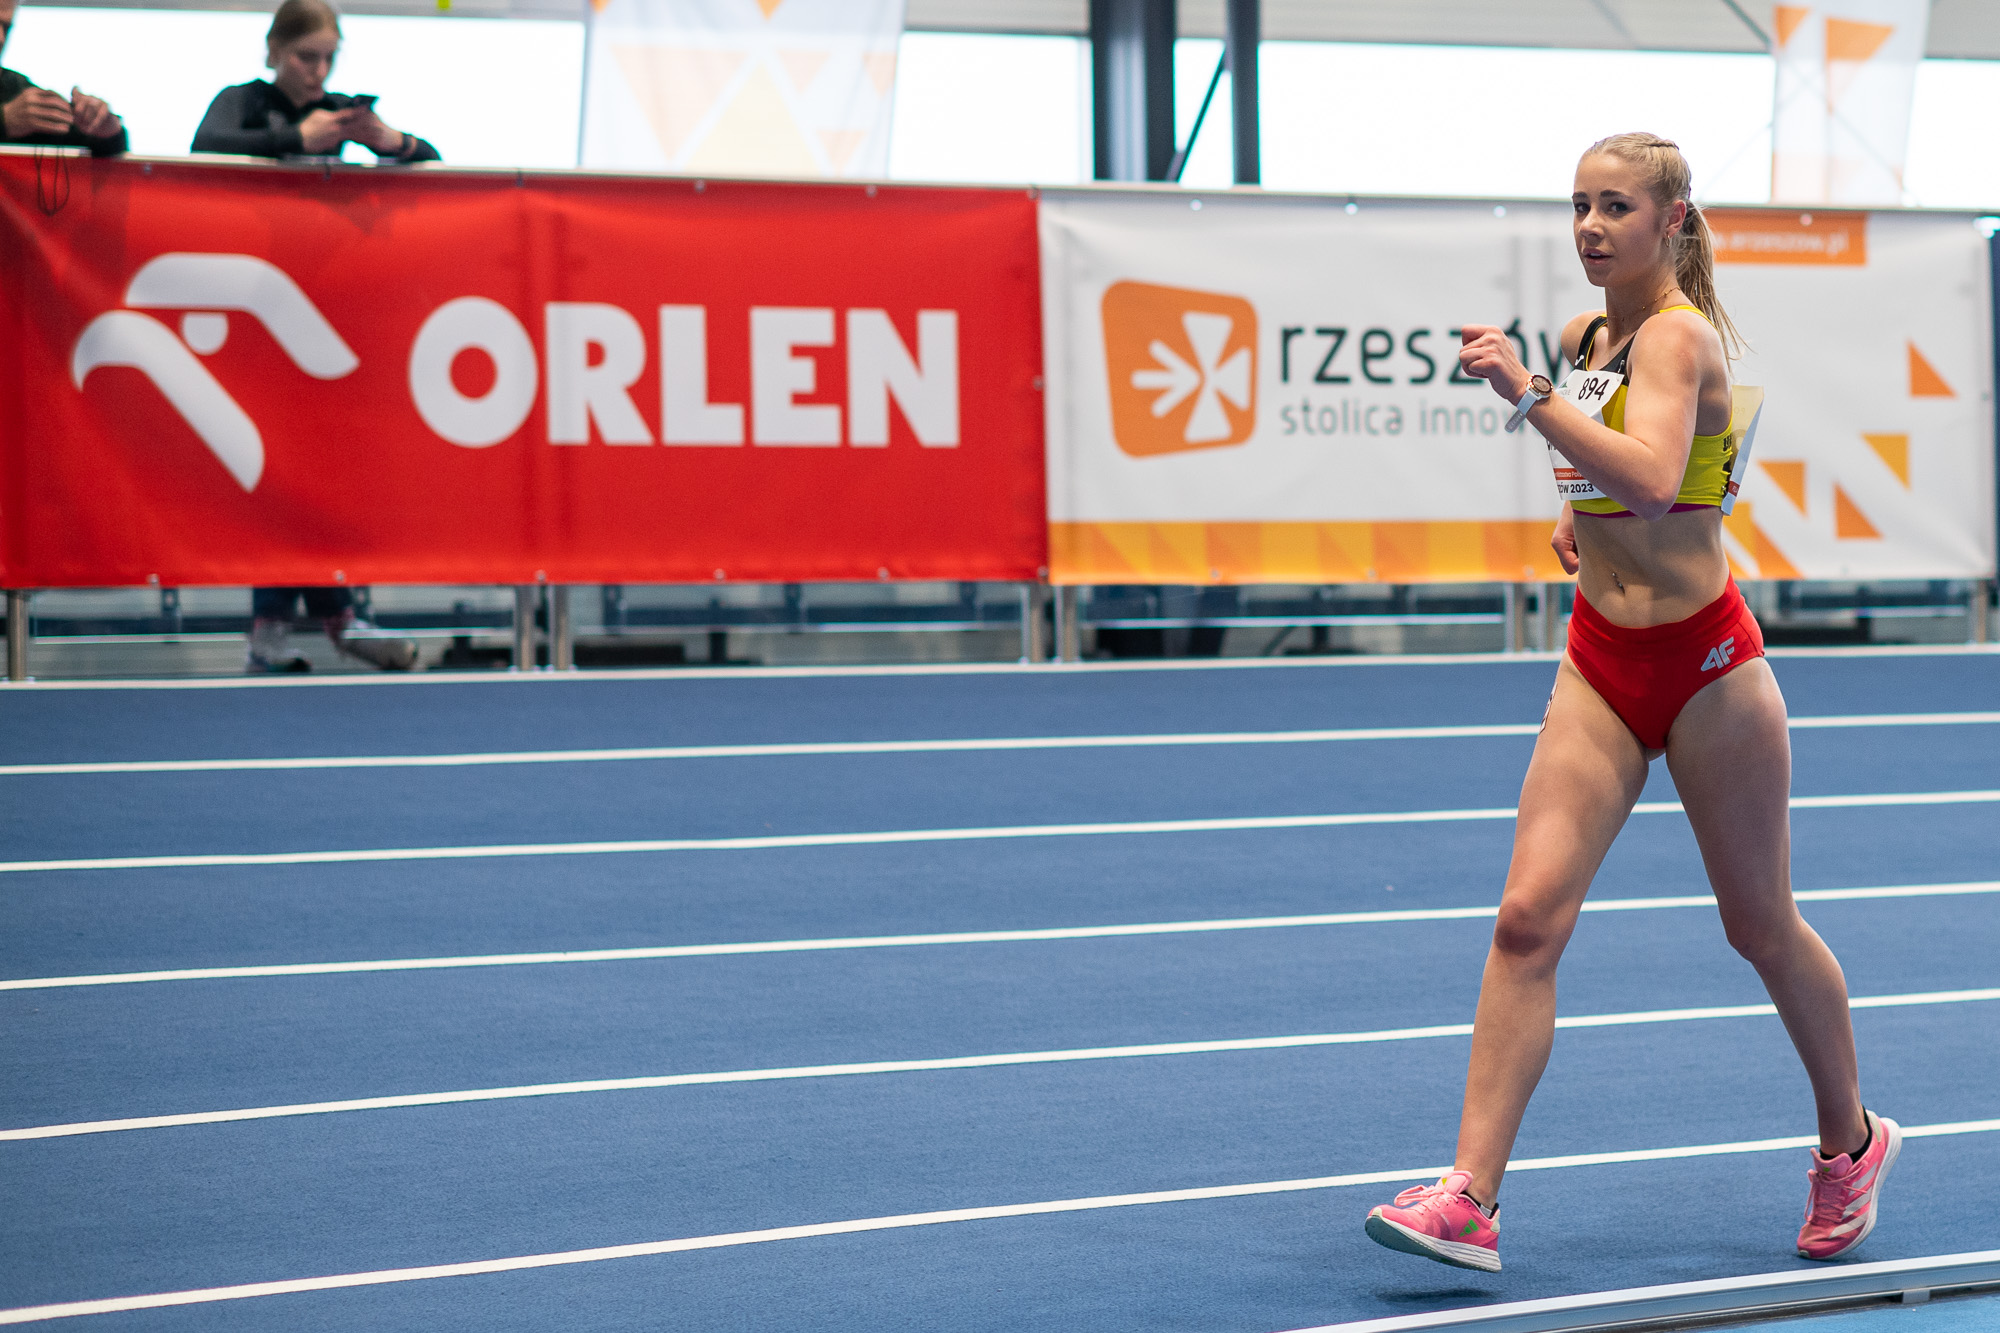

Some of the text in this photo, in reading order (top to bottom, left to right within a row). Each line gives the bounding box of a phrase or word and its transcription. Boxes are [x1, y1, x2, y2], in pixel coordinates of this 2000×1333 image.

[408, 296, 960, 449] ORLEN
[1578, 377, 1609, 400] 894
[1280, 398, 1403, 436] stolica
[1570, 483, 1594, 493] 2023
[1701, 636, 1734, 672] 4F
